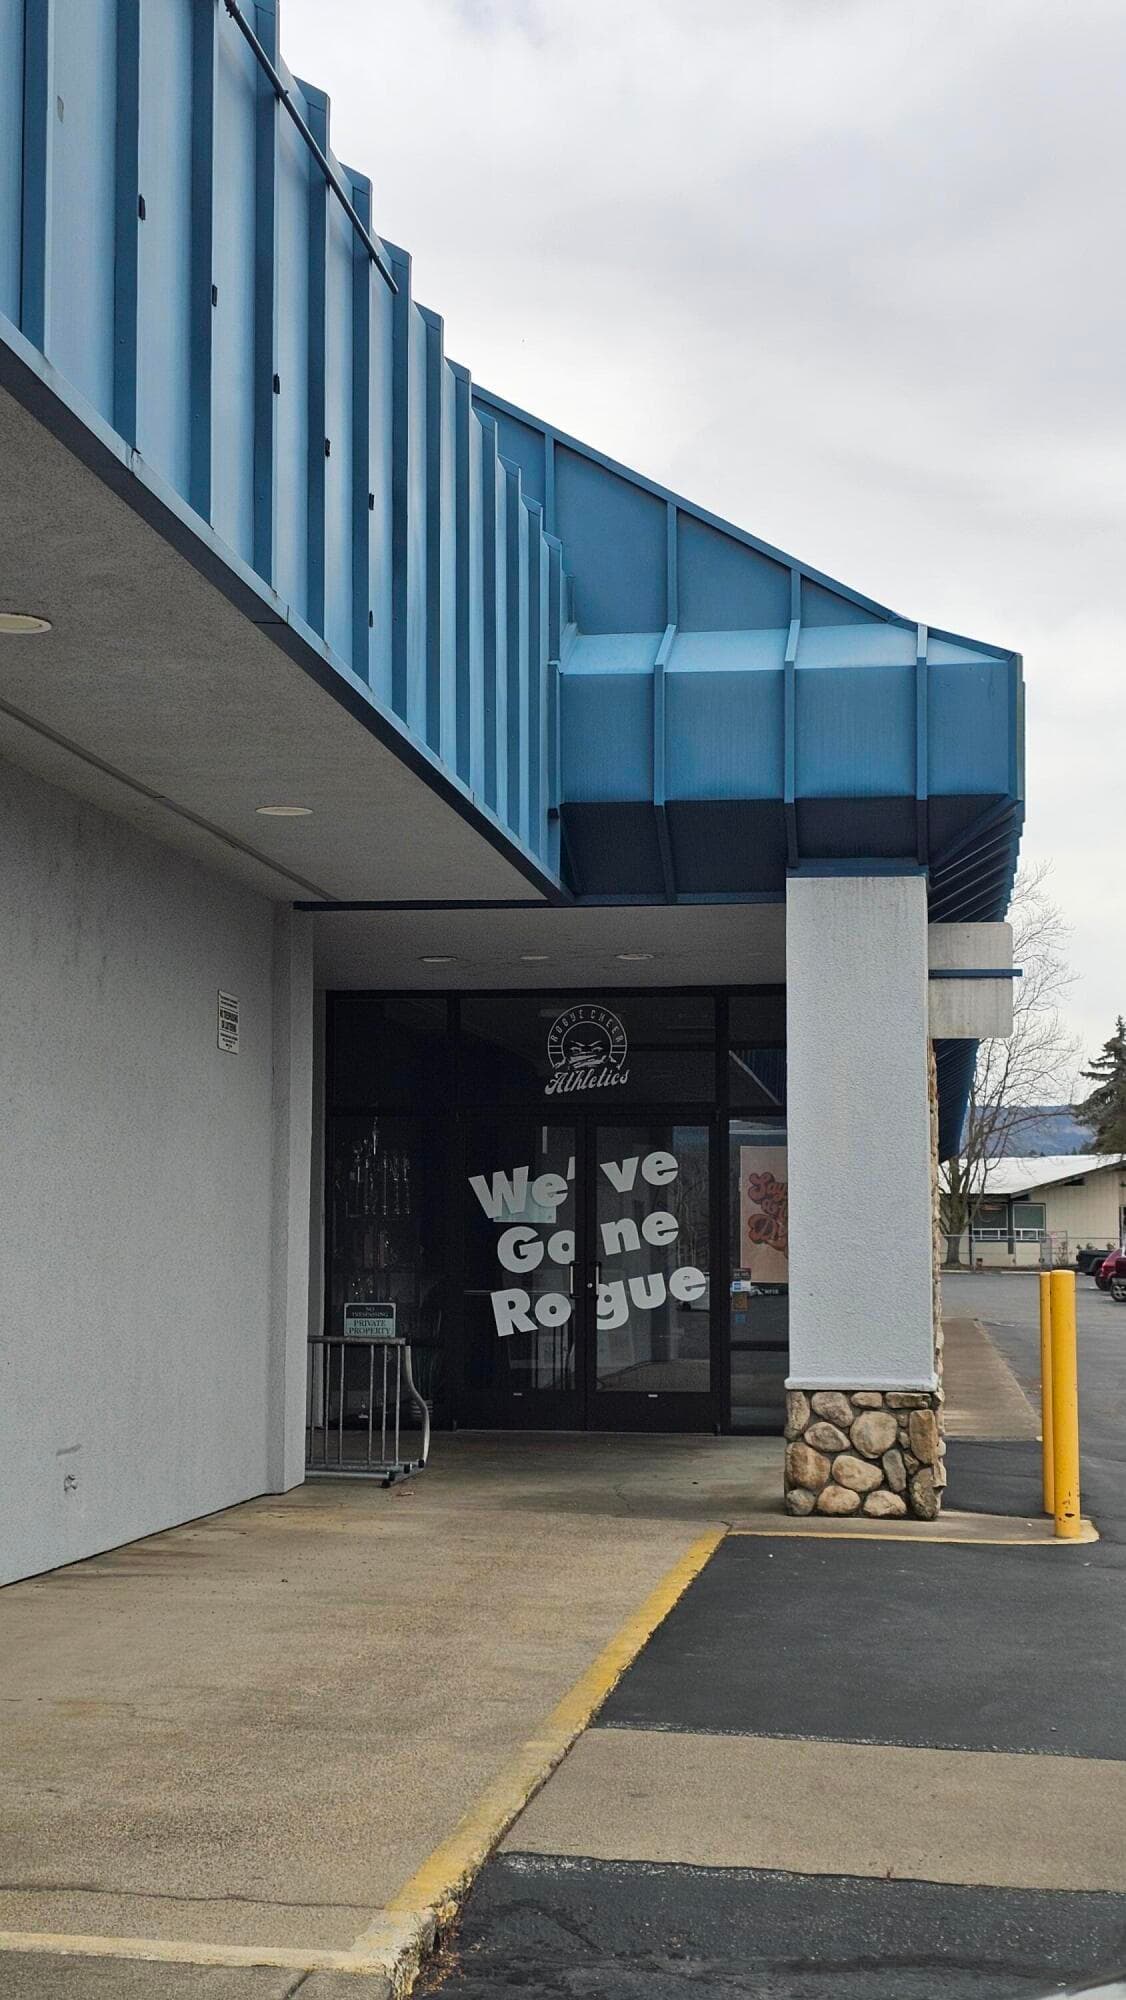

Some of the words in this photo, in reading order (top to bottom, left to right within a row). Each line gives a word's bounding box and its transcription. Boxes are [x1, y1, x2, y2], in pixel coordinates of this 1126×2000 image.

[550, 1009, 585, 1042] ROGUE
[590, 1009, 624, 1043] CHEER
[544, 1067, 630, 1095] Athletics
[497, 1211, 679, 1274] Gone
[490, 1266, 707, 1337] Rogue
[349, 1327, 391, 1335] PROPERTY
[353, 1319, 387, 1327] PRIVATE
